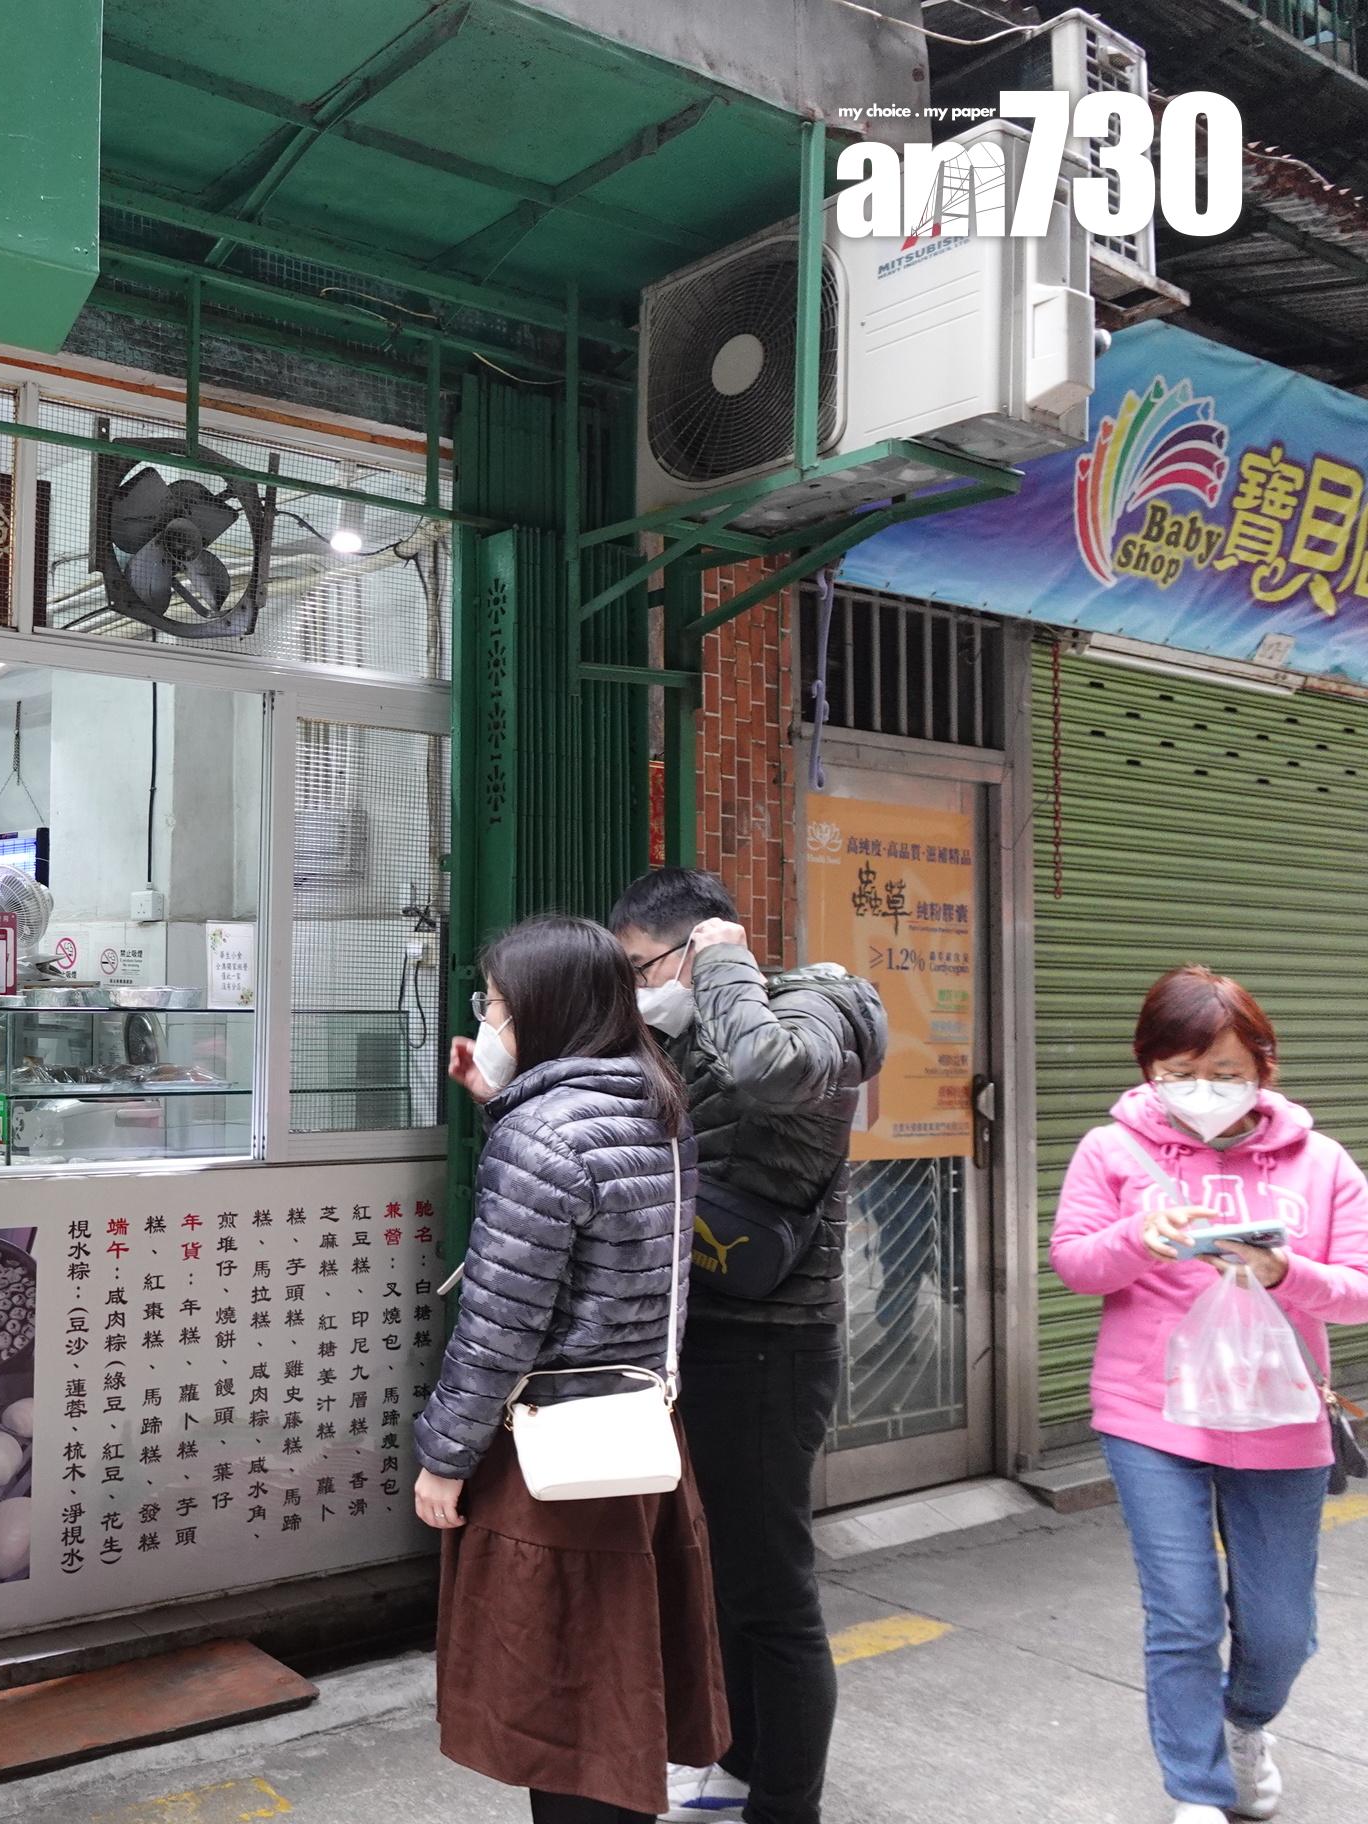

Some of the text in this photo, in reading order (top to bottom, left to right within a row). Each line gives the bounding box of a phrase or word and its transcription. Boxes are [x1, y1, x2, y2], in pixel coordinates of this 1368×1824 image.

[877, 236, 966, 275] MITSUBISH
[1142, 503, 1223, 565] Baby
[1214, 441, 1368, 616] 寶貝
[1117, 539, 1182, 585] Shop
